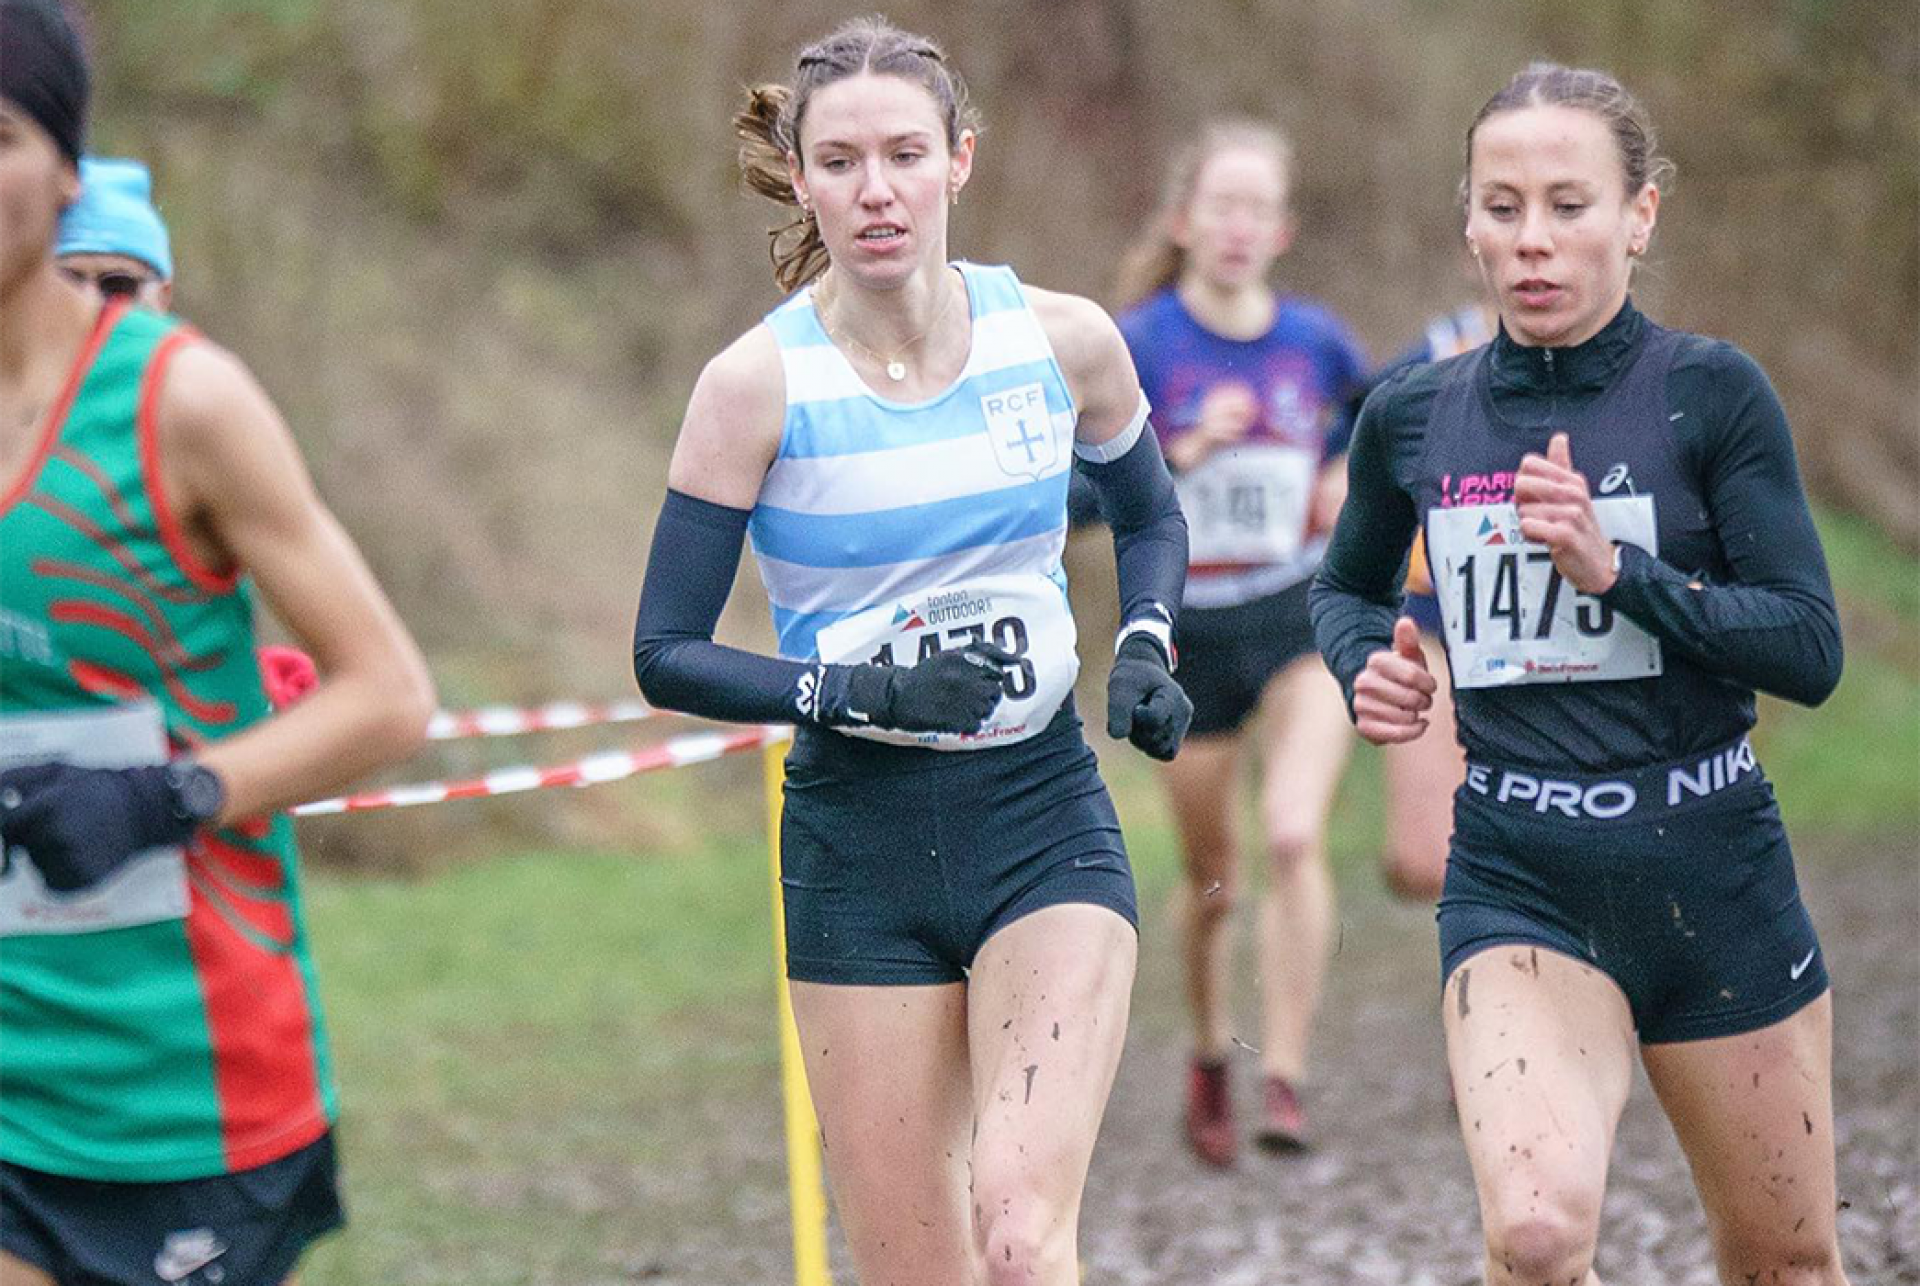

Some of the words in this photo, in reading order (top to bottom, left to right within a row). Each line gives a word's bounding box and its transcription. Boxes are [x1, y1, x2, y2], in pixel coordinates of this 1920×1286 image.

[987, 389, 1038, 417] RCF
[1465, 472, 1515, 494] PARI
[927, 590, 969, 608] tonton
[1497, 772, 1637, 819] PRO
